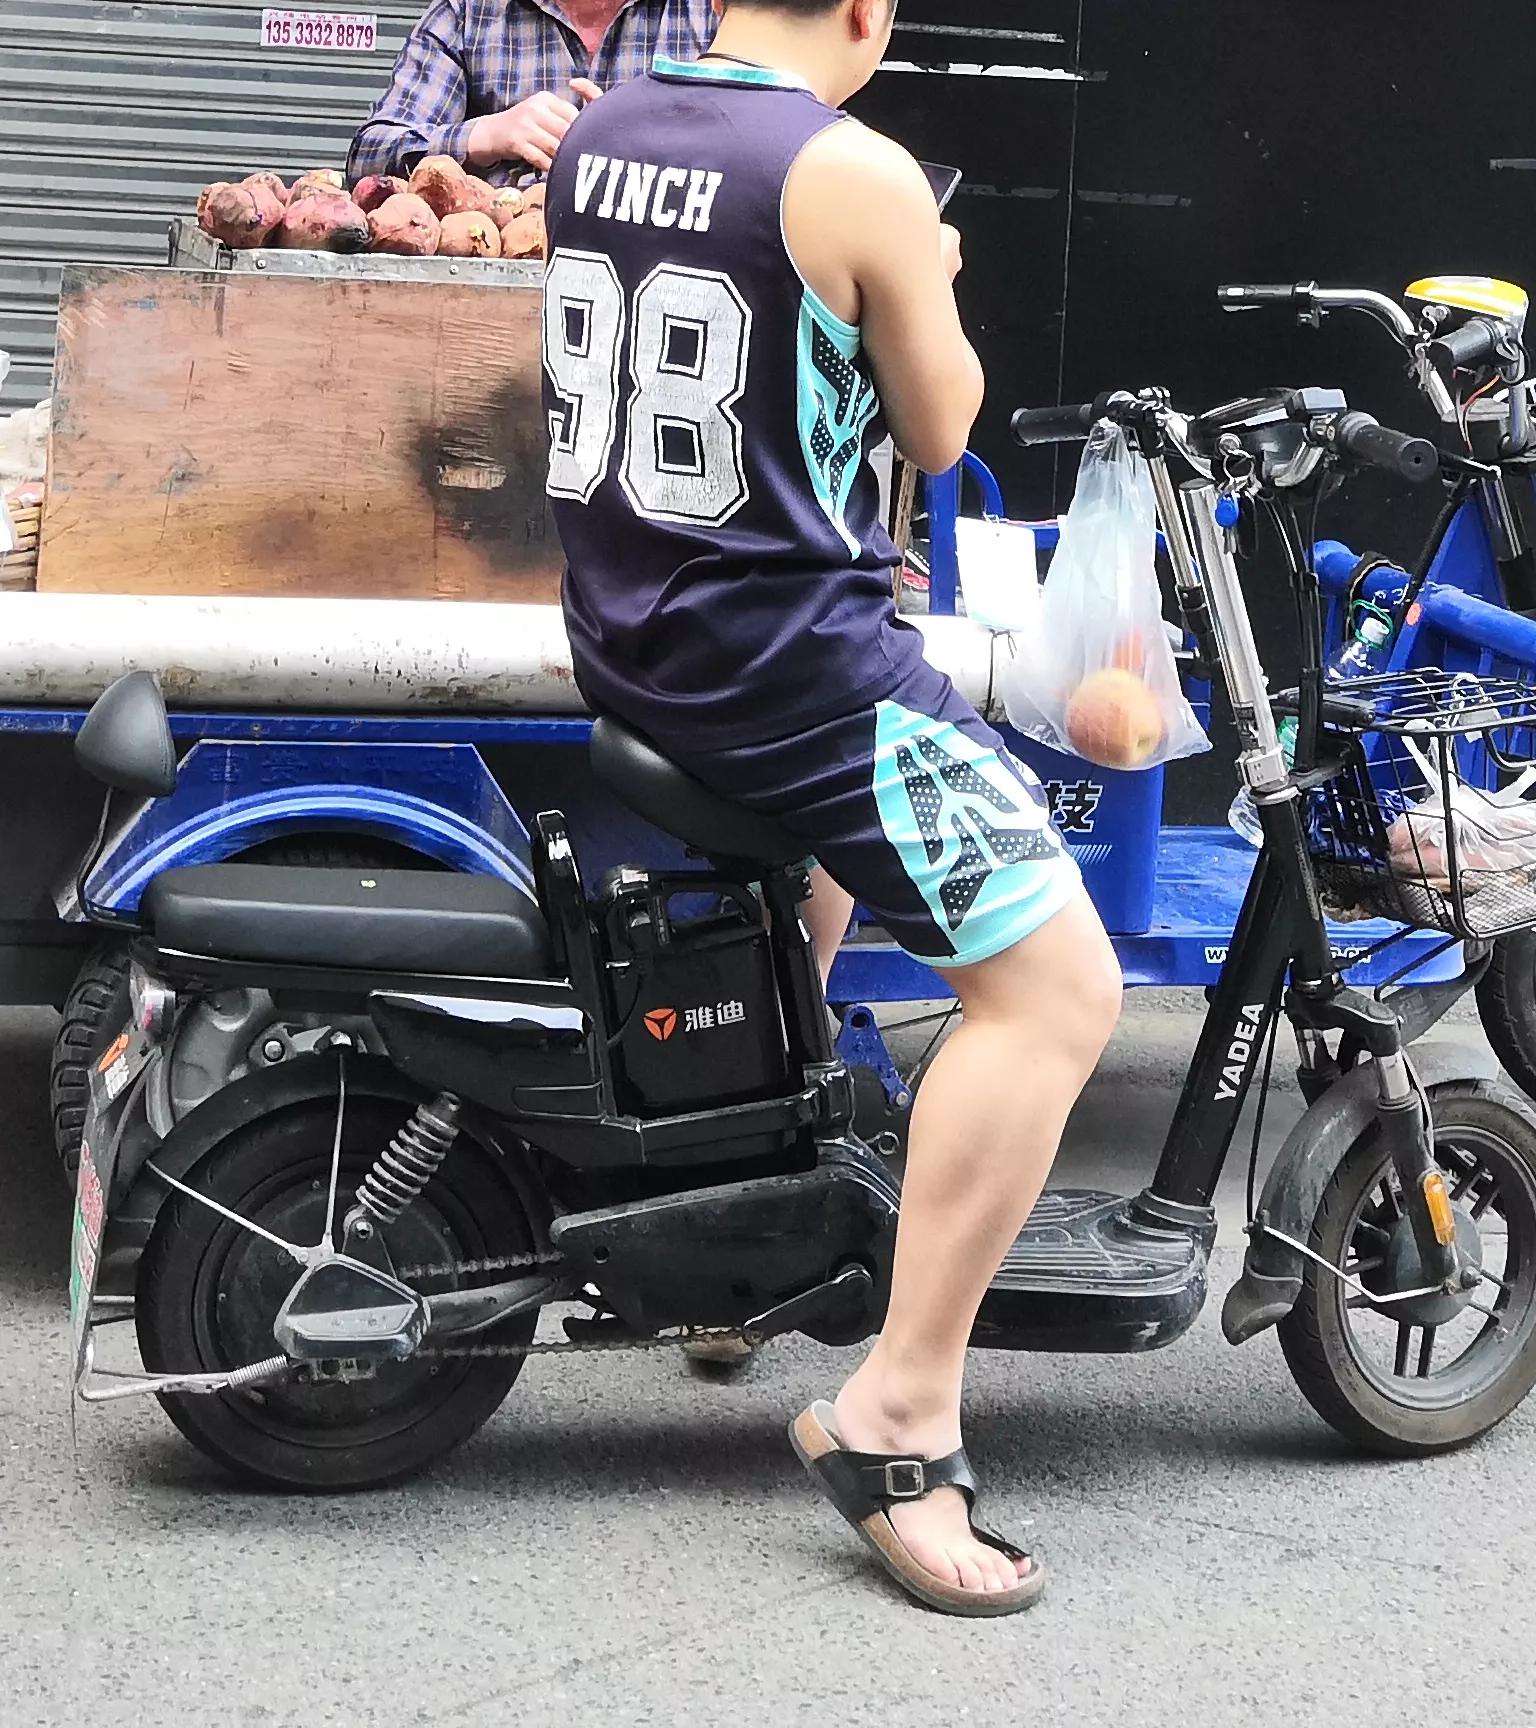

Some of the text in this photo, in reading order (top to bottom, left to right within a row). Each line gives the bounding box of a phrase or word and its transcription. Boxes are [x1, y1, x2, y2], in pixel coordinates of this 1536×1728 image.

[266, 20, 374, 48] 135 3332 8879
[574, 153, 723, 233] VINCH
[542, 246, 752, 528] 98
[684, 1000, 746, 1032] 雅迪
[1213, 1003, 1265, 1101] YADEA
